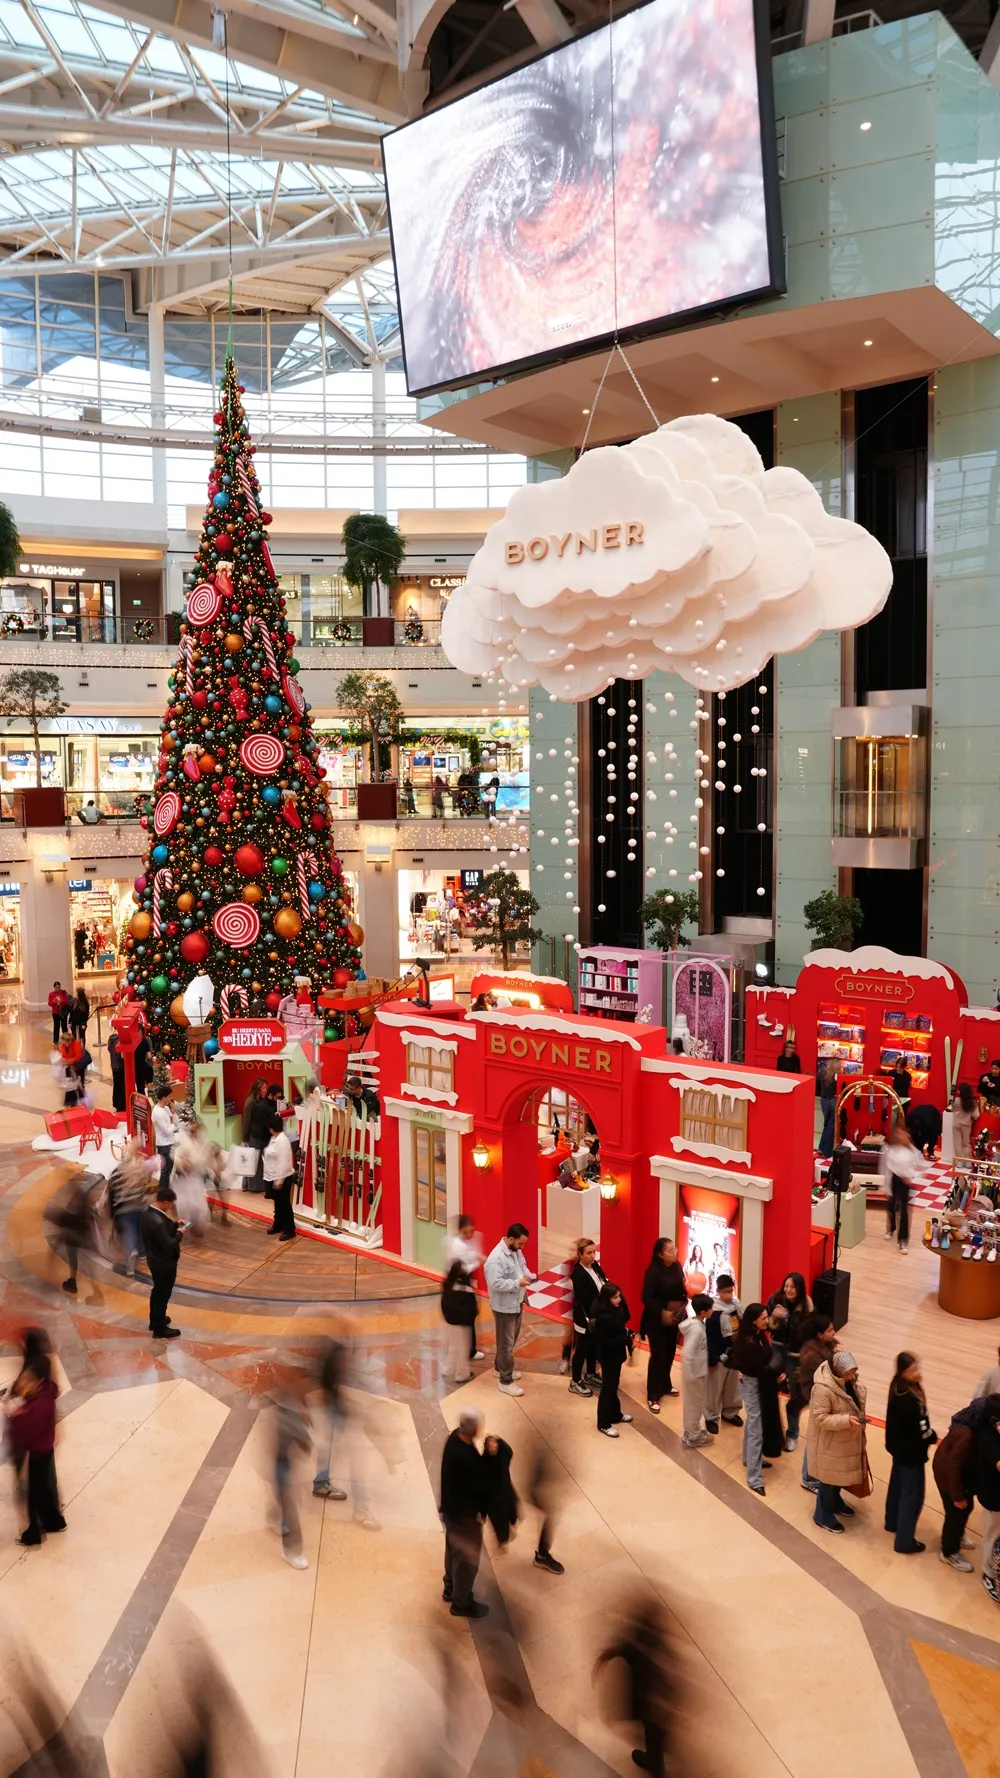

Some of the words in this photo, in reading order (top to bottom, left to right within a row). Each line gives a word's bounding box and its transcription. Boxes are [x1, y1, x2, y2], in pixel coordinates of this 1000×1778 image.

[504, 520, 645, 565] BOYNER
[50, 719, 117, 731] ATASAY
[465, 871, 479, 882] GAP
[505, 979, 533, 988] BOYNER
[846, 981, 902, 996] BOYNER
[222, 1035, 232, 1043] SEN
[490, 1033, 612, 1073] BOYNER
[236, 1061, 282, 1070] BOYNE
